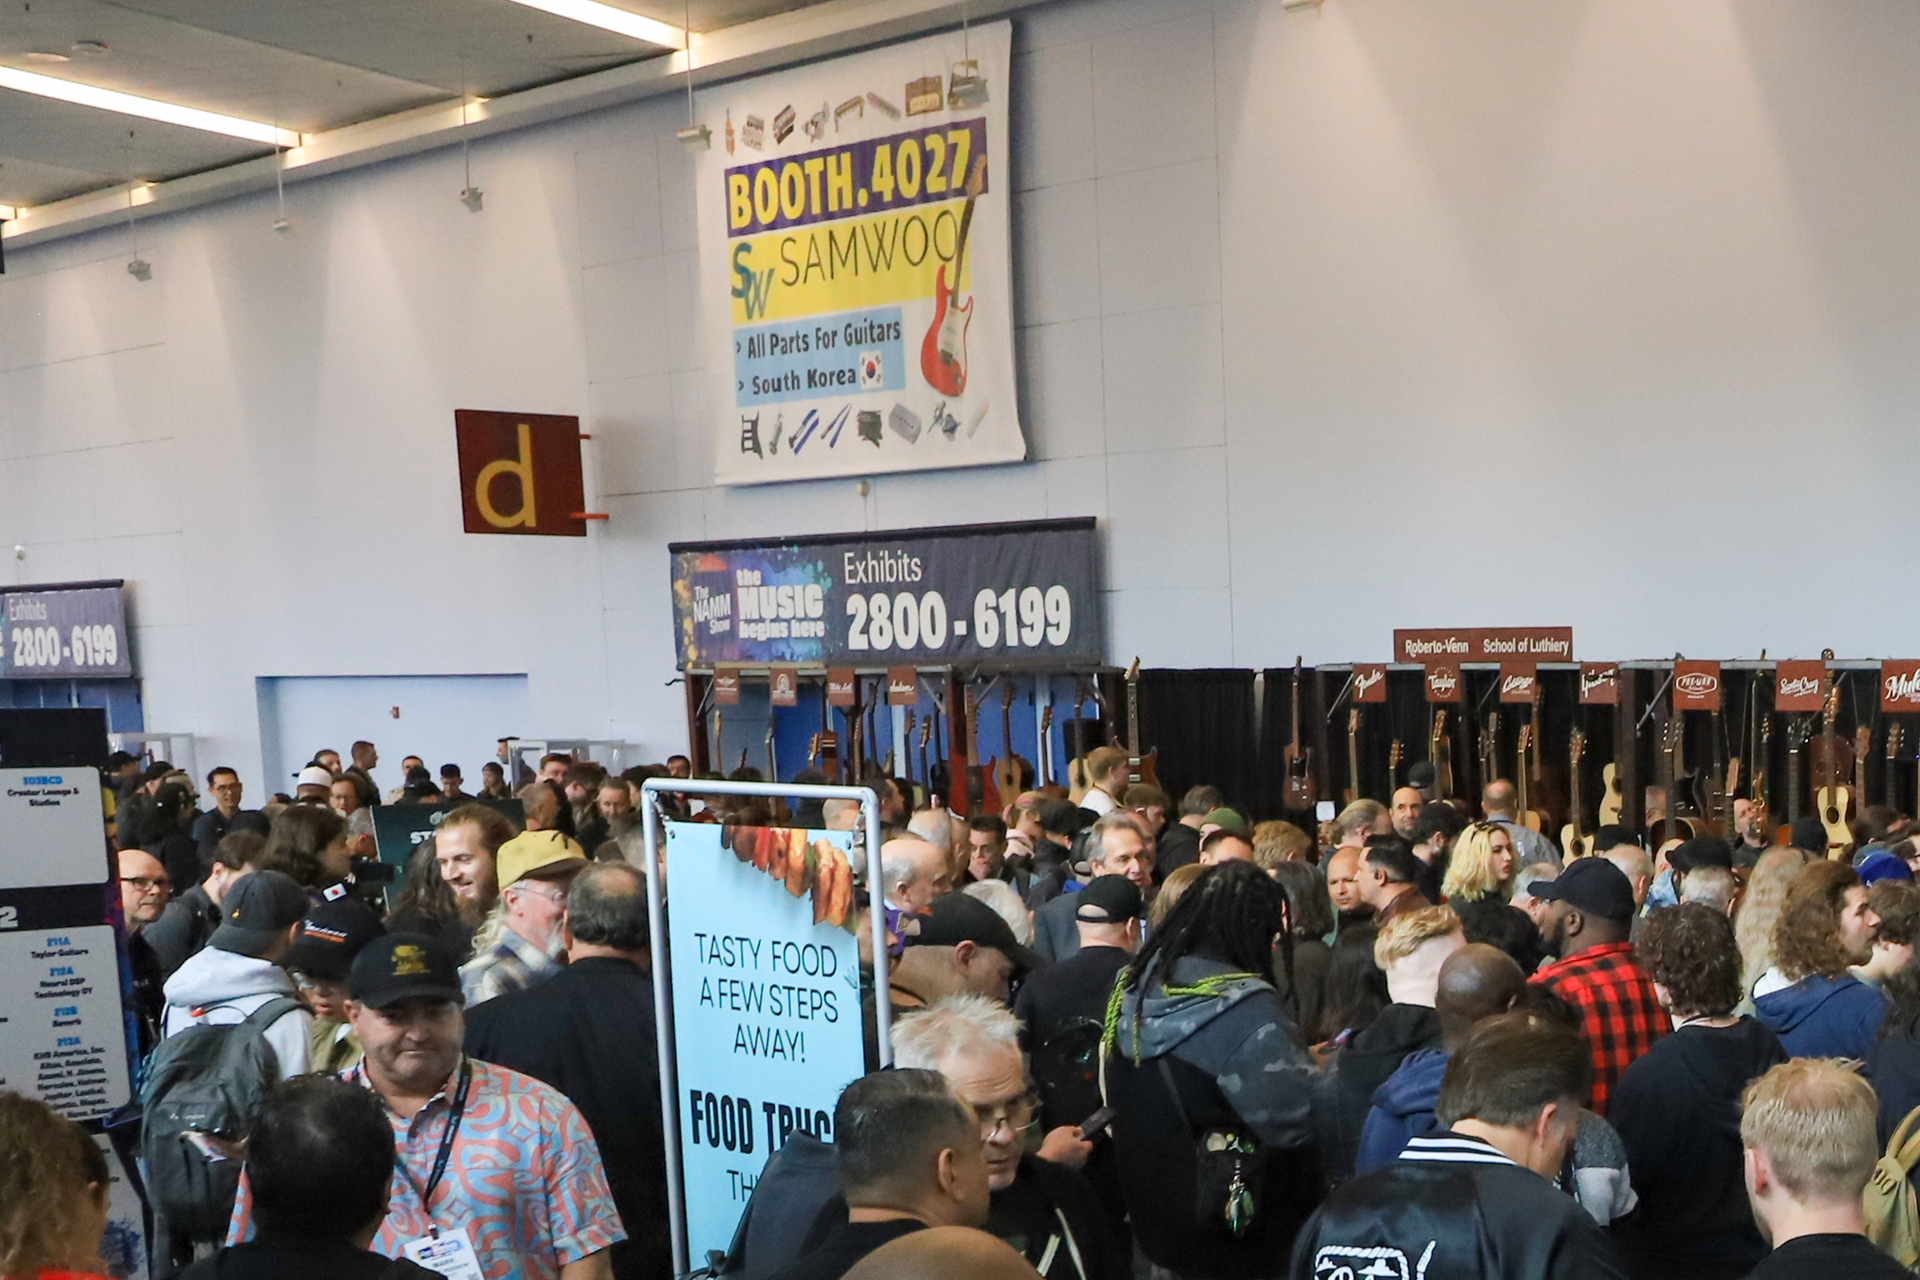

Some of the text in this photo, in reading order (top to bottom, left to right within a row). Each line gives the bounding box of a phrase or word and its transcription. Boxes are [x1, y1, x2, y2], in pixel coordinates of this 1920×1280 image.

[729, 128, 971, 230] BOOTH.4027
[780, 209, 959, 287] SAMWOO
[747, 317, 901, 359] All Parts For Guitars
[752, 365, 857, 395] South Korea
[476, 424, 536, 528] d
[736, 569, 762, 586] the
[844, 549, 922, 586] Exhibits
[693, 593, 731, 623] NAMM
[694, 586, 710, 601] The
[737, 584, 824, 620] MUSIC
[739, 619, 825, 641] begins here
[1405, 636, 1569, 658] Roberto-Venn School of Luthiery
[1427, 674, 1457, 692] Taylor
[694, 933, 838, 977] TASTY FOOD
[699, 976, 839, 1023] A FEW STEPS
[734, 1024, 806, 1063] AWAY!
[690, 1089, 754, 1154] FOOD
[726, 1169, 759, 1202] TH
